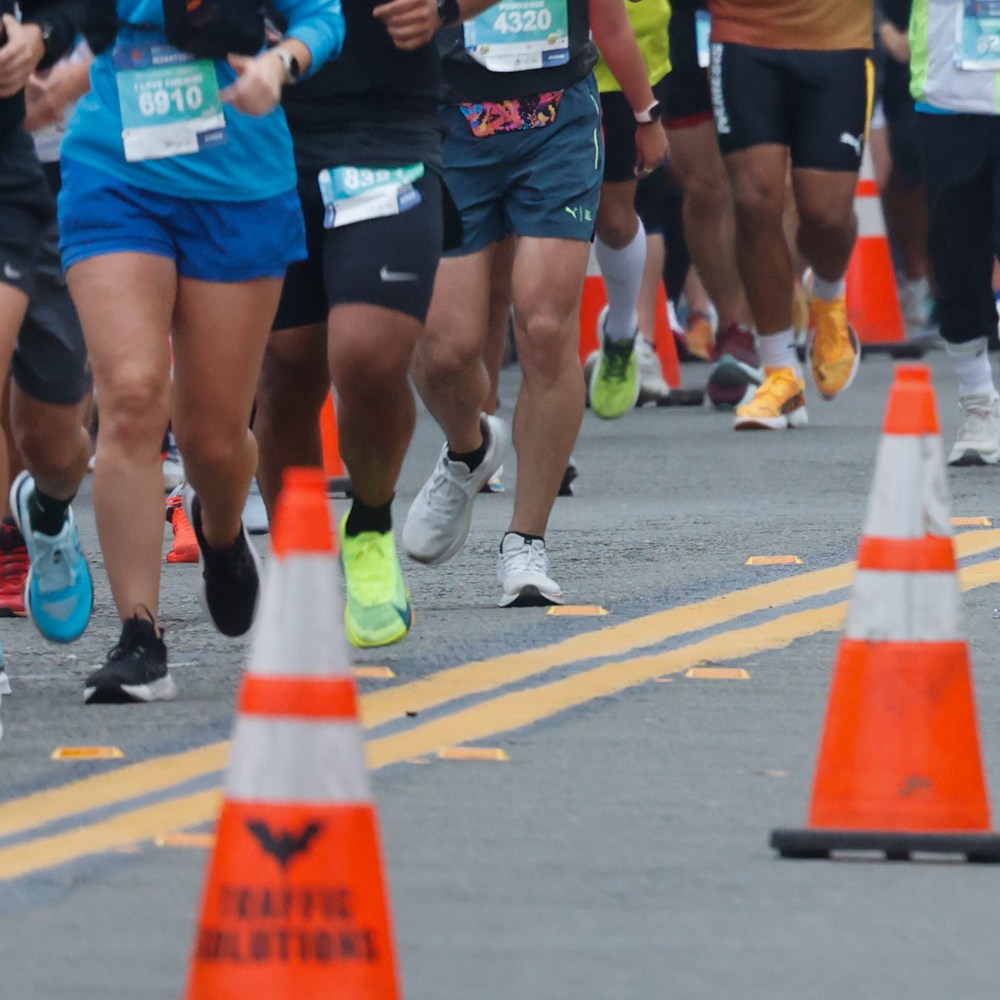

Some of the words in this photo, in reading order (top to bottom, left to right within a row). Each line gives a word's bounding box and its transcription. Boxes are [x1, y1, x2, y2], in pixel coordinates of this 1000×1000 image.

[493, 8, 552, 34] 4320
[139, 86, 203, 116] 6910
[220, 885, 353, 919] TRAFFIC
[199, 926, 379, 963] SOLUTIONS
